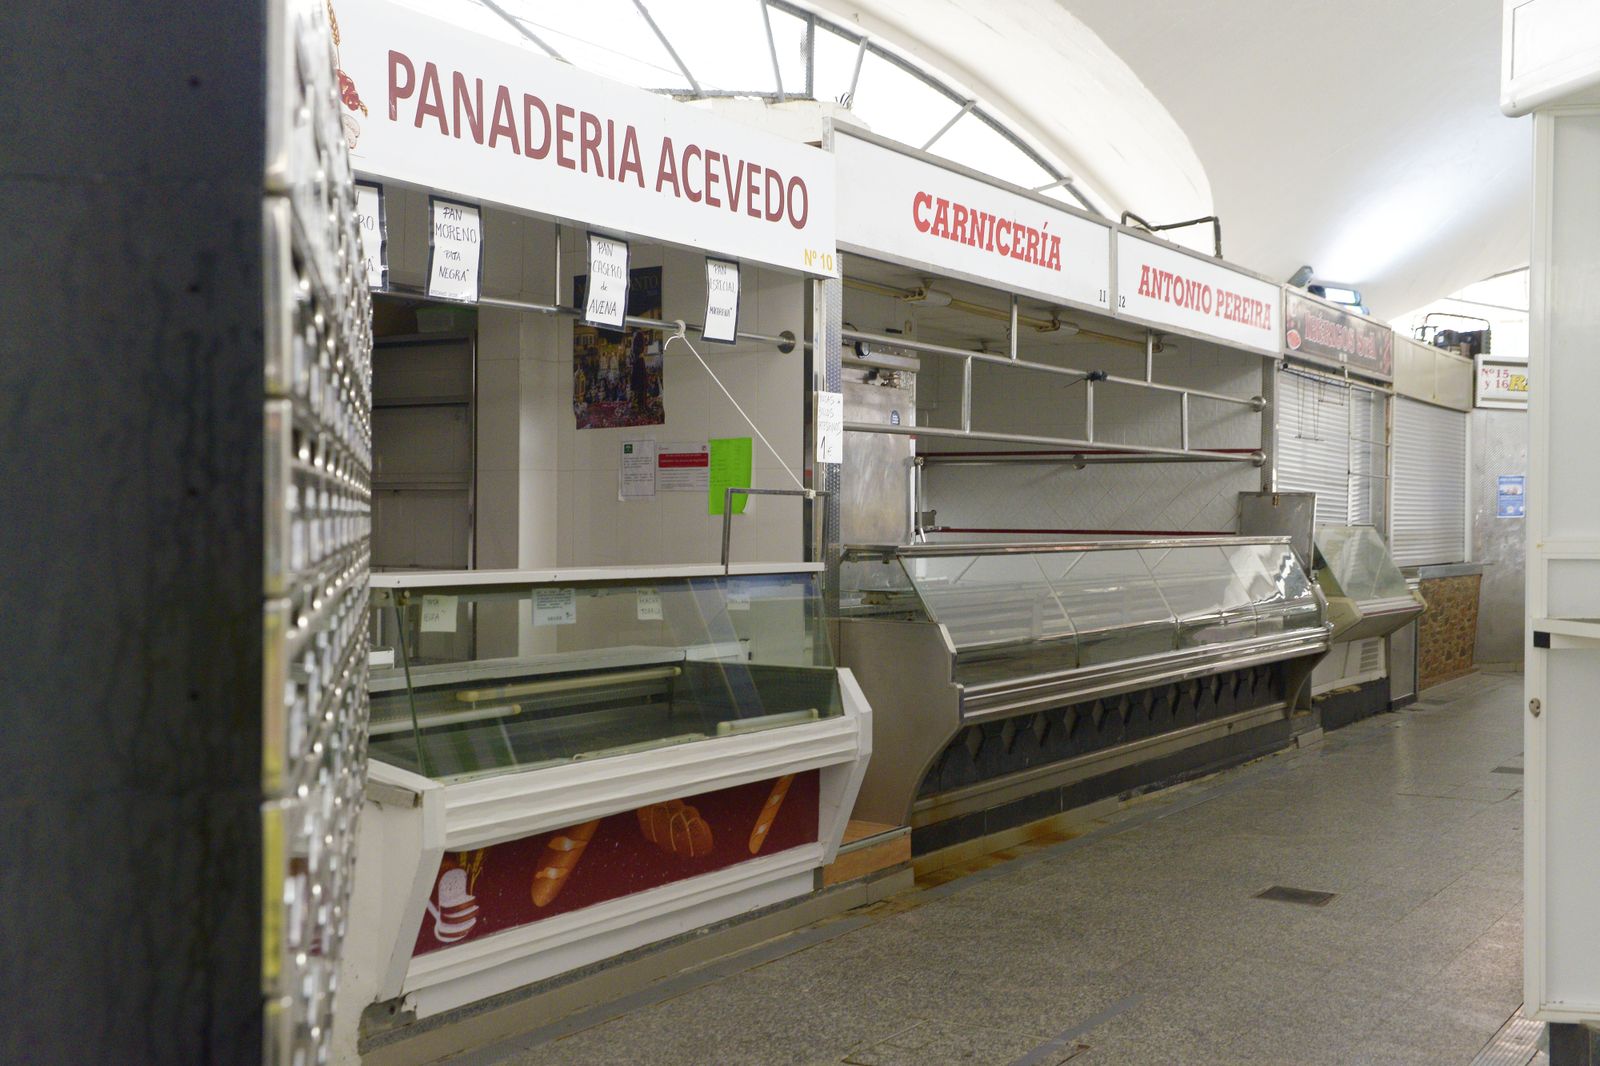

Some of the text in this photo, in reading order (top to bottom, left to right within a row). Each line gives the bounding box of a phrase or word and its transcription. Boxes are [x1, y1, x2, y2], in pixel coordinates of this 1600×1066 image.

[388, 49, 809, 230] PANADERIA ACEVEDO
[443, 206, 462, 221] PAN
[435, 222, 477, 244] MORENO
[912, 190, 1063, 273] CARNICERÍA
[597, 241, 614, 256] PAN
[592, 259, 622, 279] CASERO
[820, 253, 833, 271] 10
[1099, 289, 1106, 303] 11
[1118, 295, 1126, 308] 12
[1138, 263, 1272, 331] ANTONIO PEREIRA
[589, 299, 617, 316] AVENA
[1496, 369, 1509, 378] 15
[1496, 379, 1508, 388] 16
